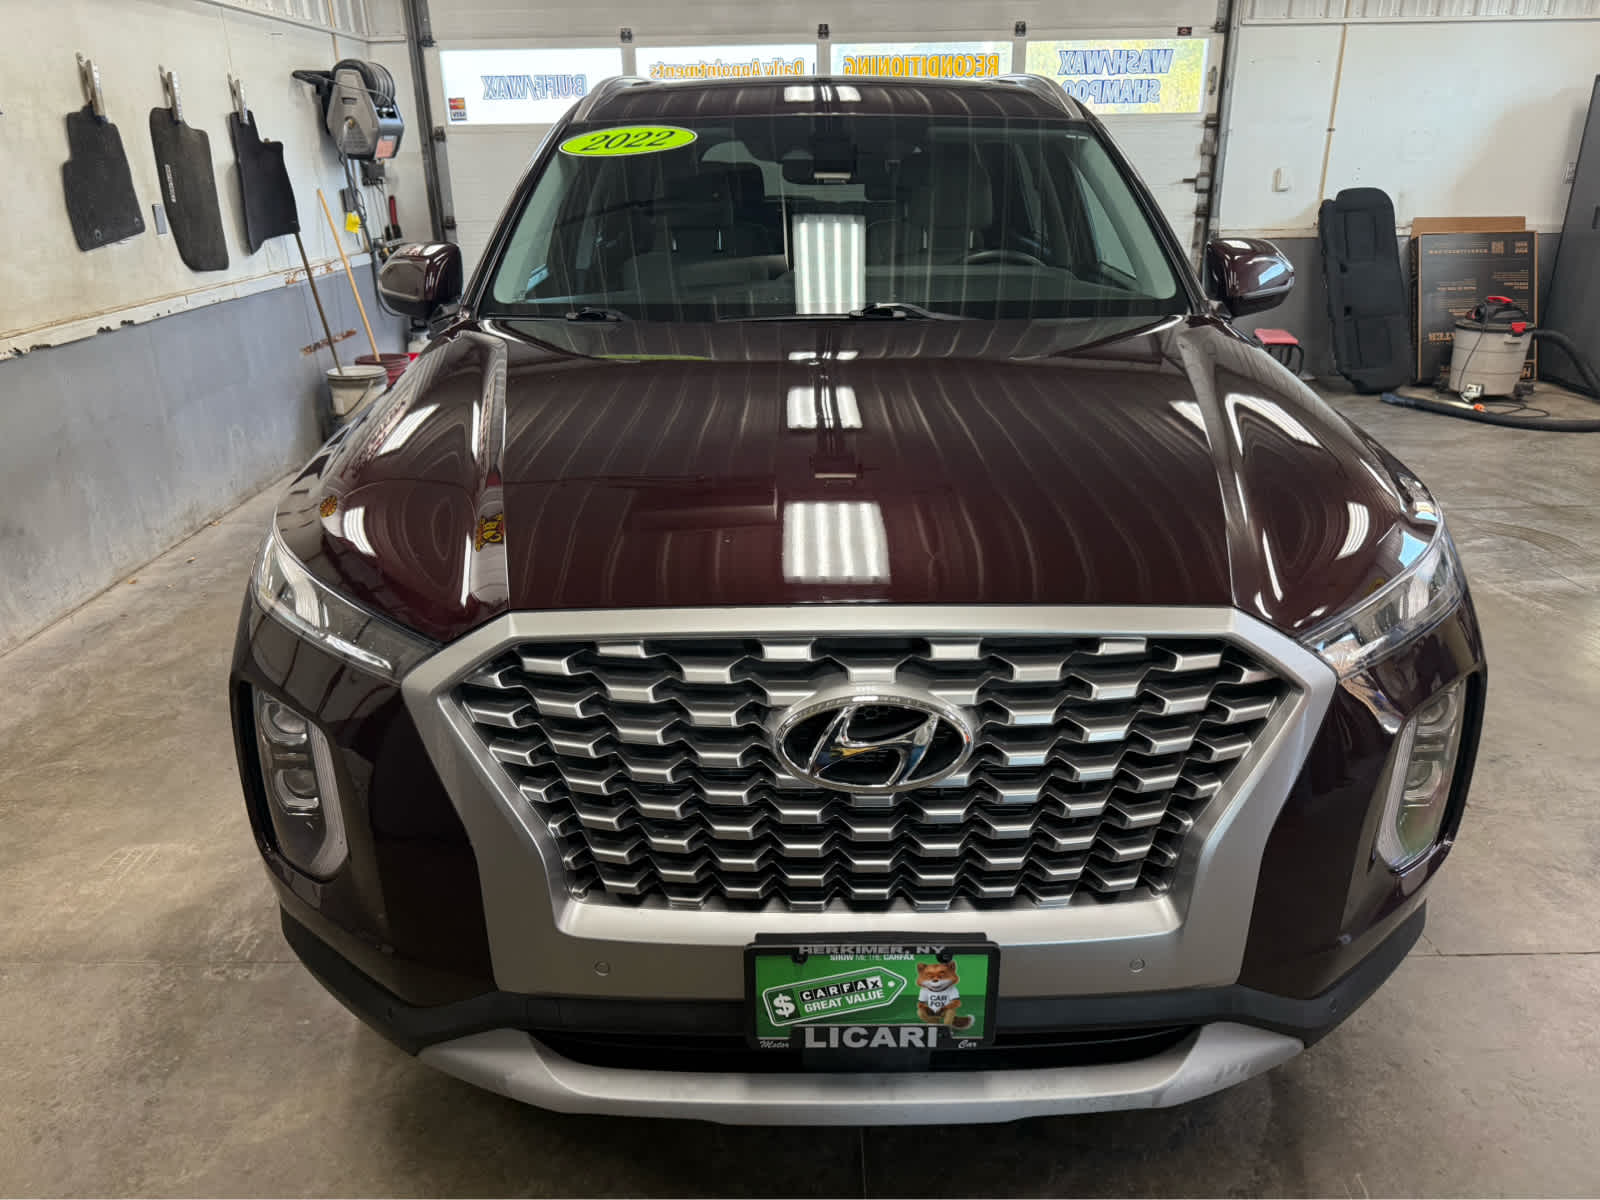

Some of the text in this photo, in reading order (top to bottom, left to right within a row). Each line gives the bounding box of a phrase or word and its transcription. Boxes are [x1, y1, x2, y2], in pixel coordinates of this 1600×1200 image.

[588, 130, 676, 151] 2022
[883, 953, 915, 961] CARFAX
[916, 945, 945, 954] NY
[801, 978, 882, 1001] CARFAX
[804, 989, 885, 1013] GREAT VALUE
[759, 1040, 790, 1049] Motor
[804, 1026, 938, 1049] LICARI
[958, 1040, 977, 1049] Car
